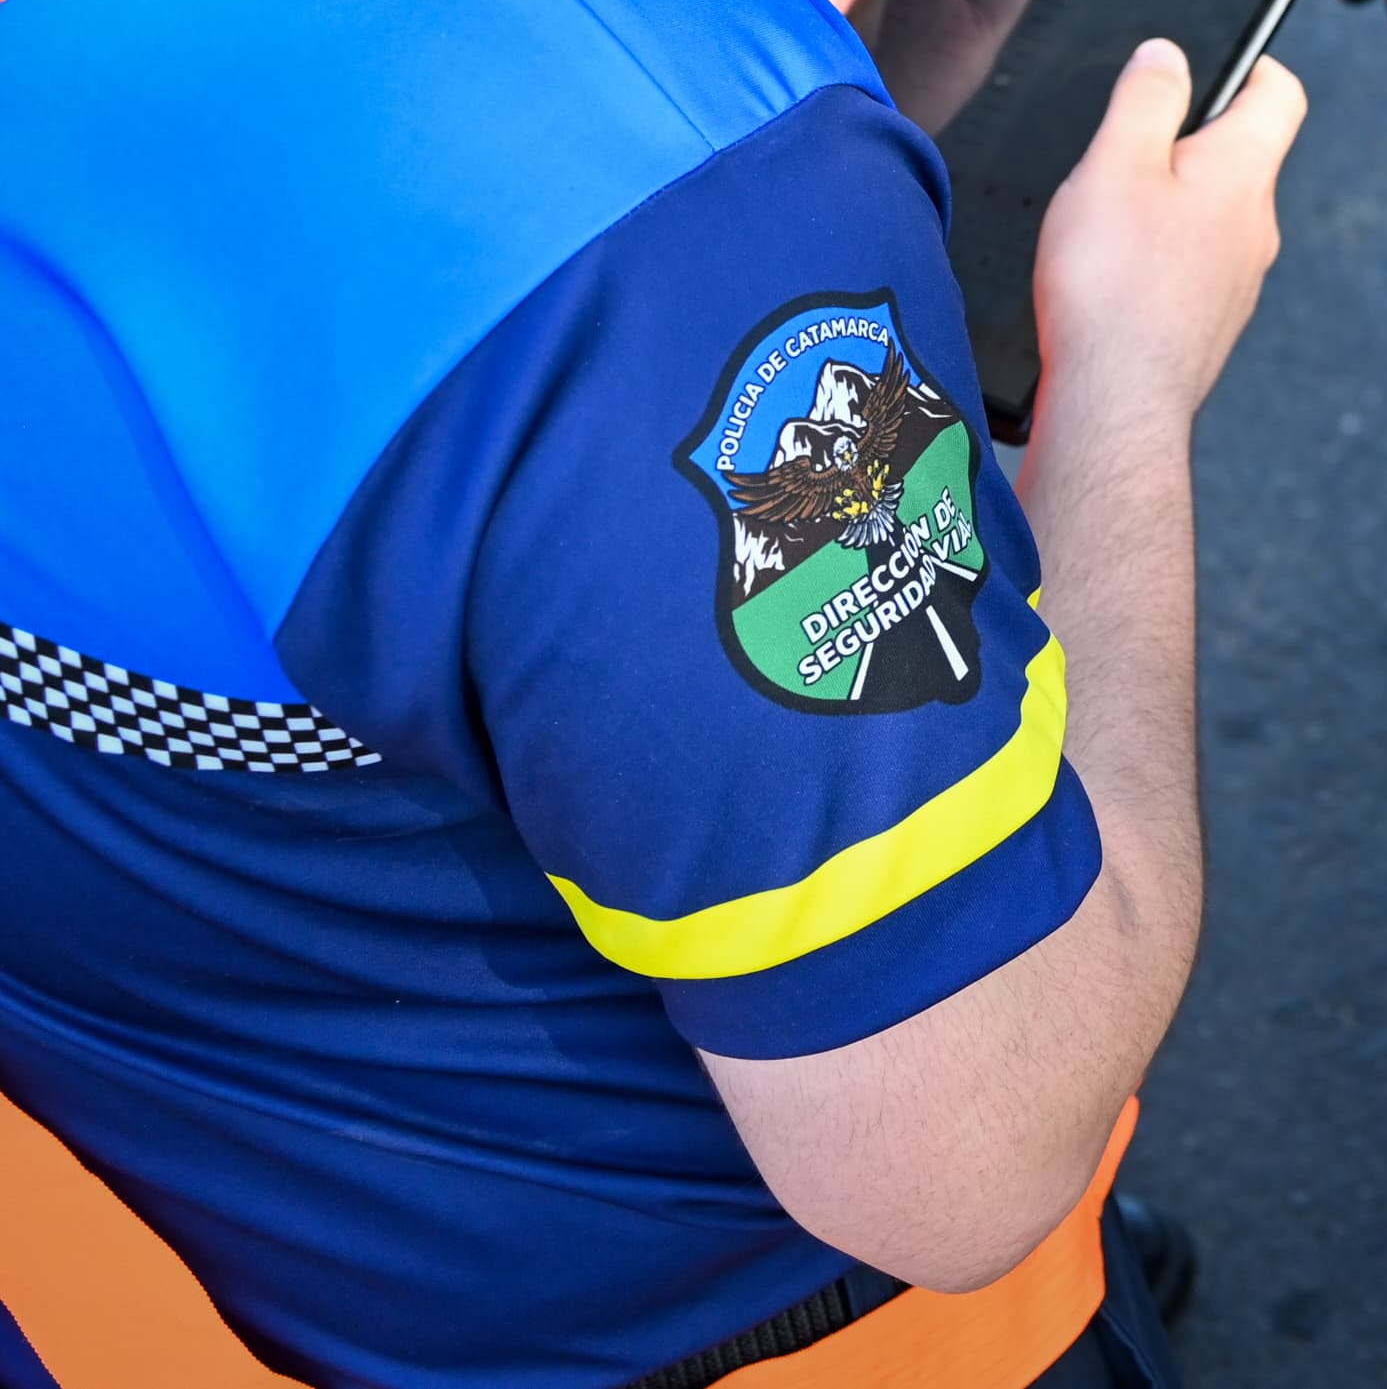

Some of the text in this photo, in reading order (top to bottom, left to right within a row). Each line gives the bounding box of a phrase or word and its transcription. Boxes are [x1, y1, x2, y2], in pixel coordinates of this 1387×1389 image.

[716, 317, 889, 471] POLICIA DE CATAMARCA
[797, 509, 972, 685] SEGURIDAD VIAL
[802, 486, 956, 644] DIRECCIÓN DE
